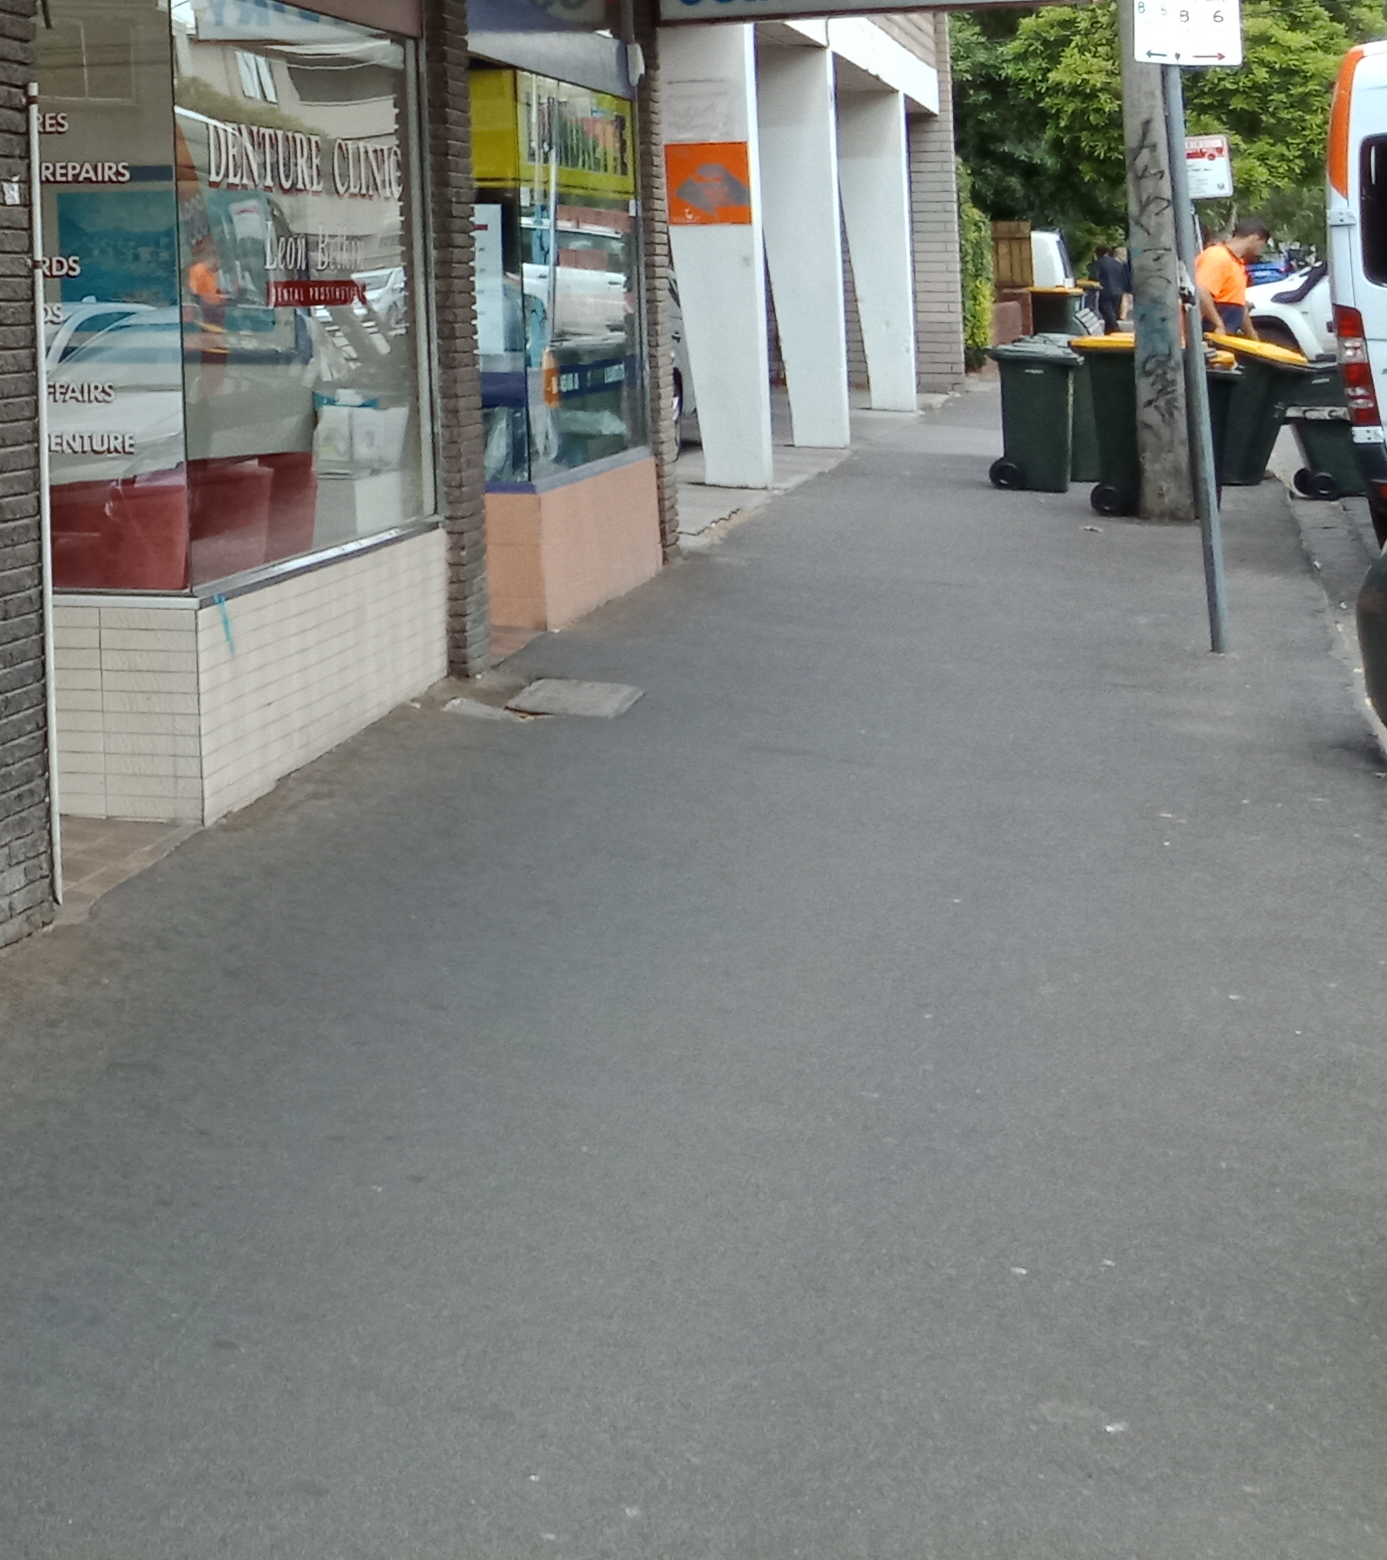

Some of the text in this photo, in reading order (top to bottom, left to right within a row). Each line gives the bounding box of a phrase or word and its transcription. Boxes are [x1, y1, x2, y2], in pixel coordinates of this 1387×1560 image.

[41, 162, 130, 184] REPAIRS
[206, 122, 403, 199] DENTURE CLINIC
[264, 221, 307, 271] Leon
[49, 431, 135, 454] ENTURE
